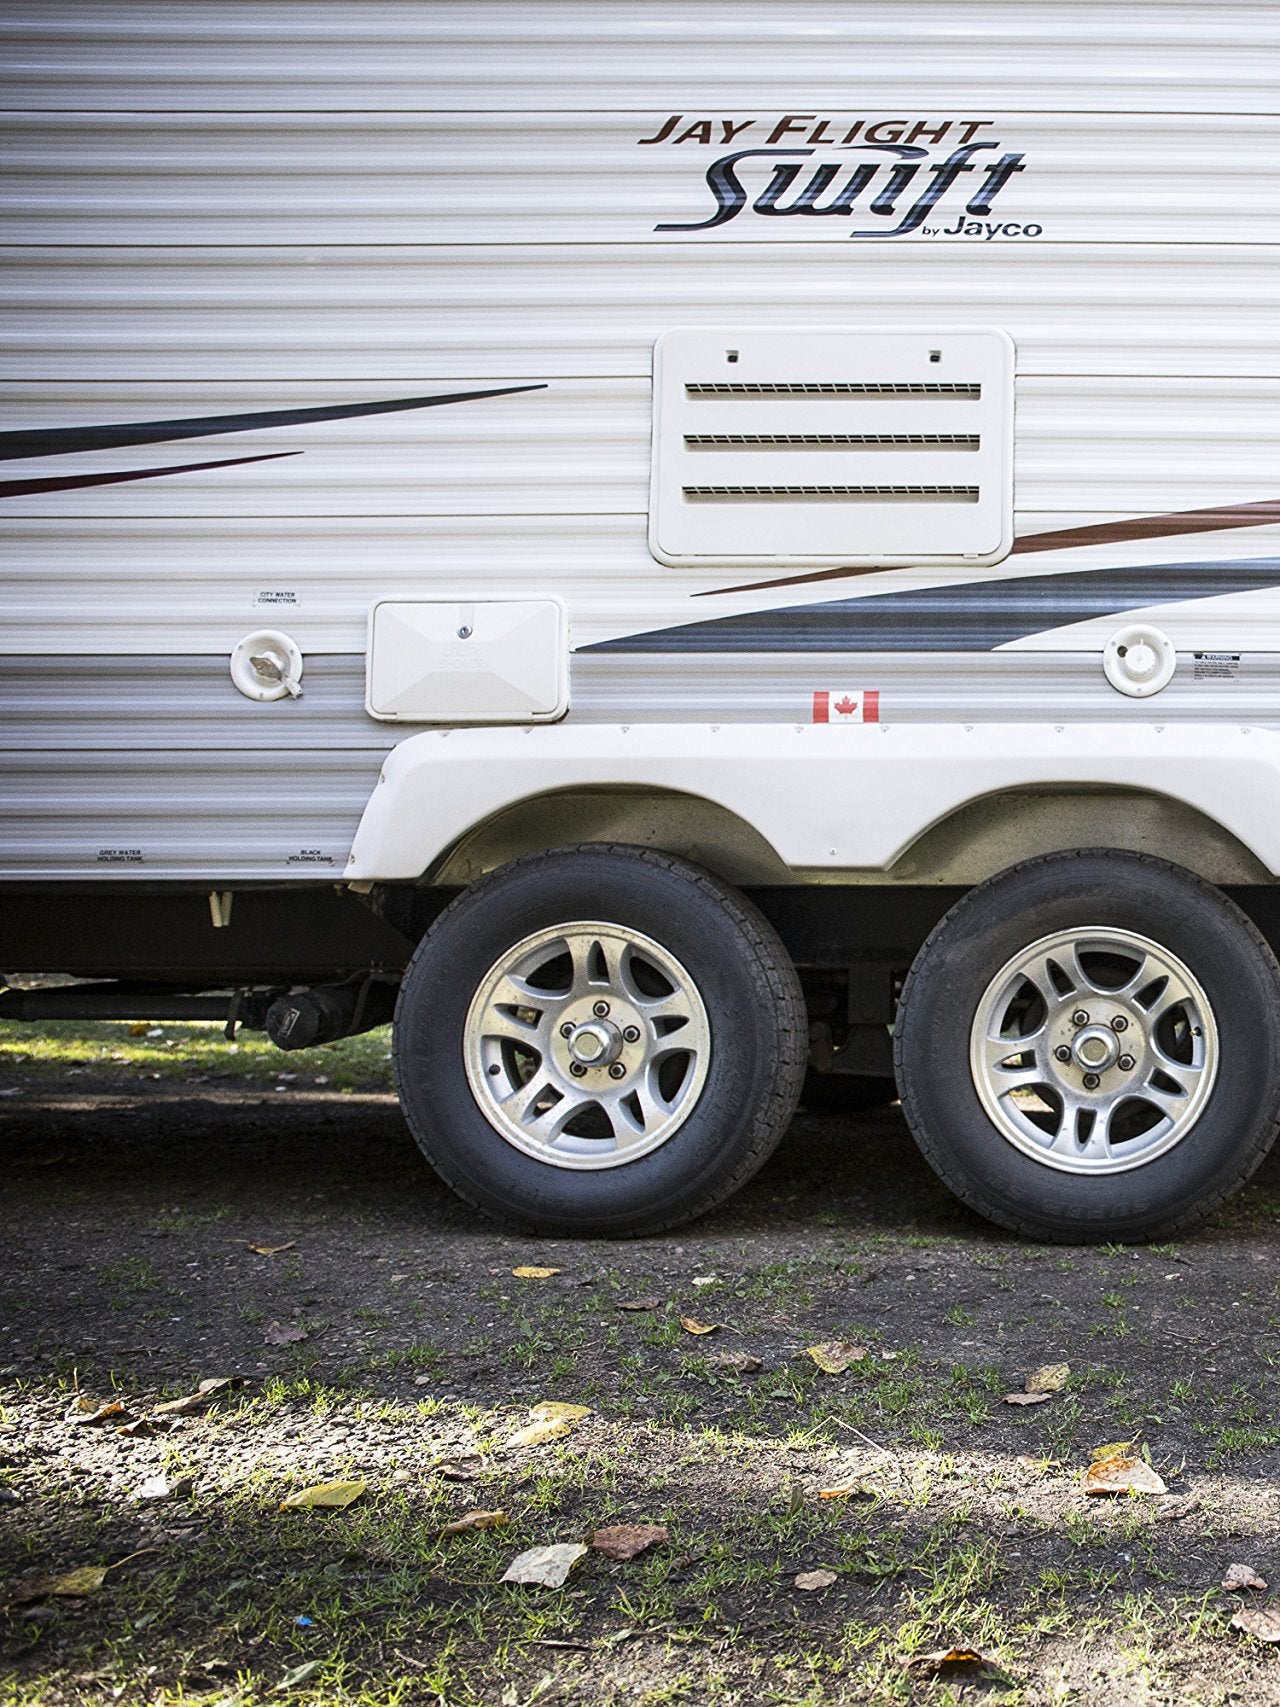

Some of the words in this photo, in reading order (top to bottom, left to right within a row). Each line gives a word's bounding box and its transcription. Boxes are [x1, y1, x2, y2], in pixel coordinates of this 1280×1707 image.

[637, 115, 757, 145] JAY
[765, 115, 995, 145] FLIGHT
[653, 142, 1027, 238] Swift
[921, 225, 940, 238] by
[943, 216, 1043, 241] Jayco
